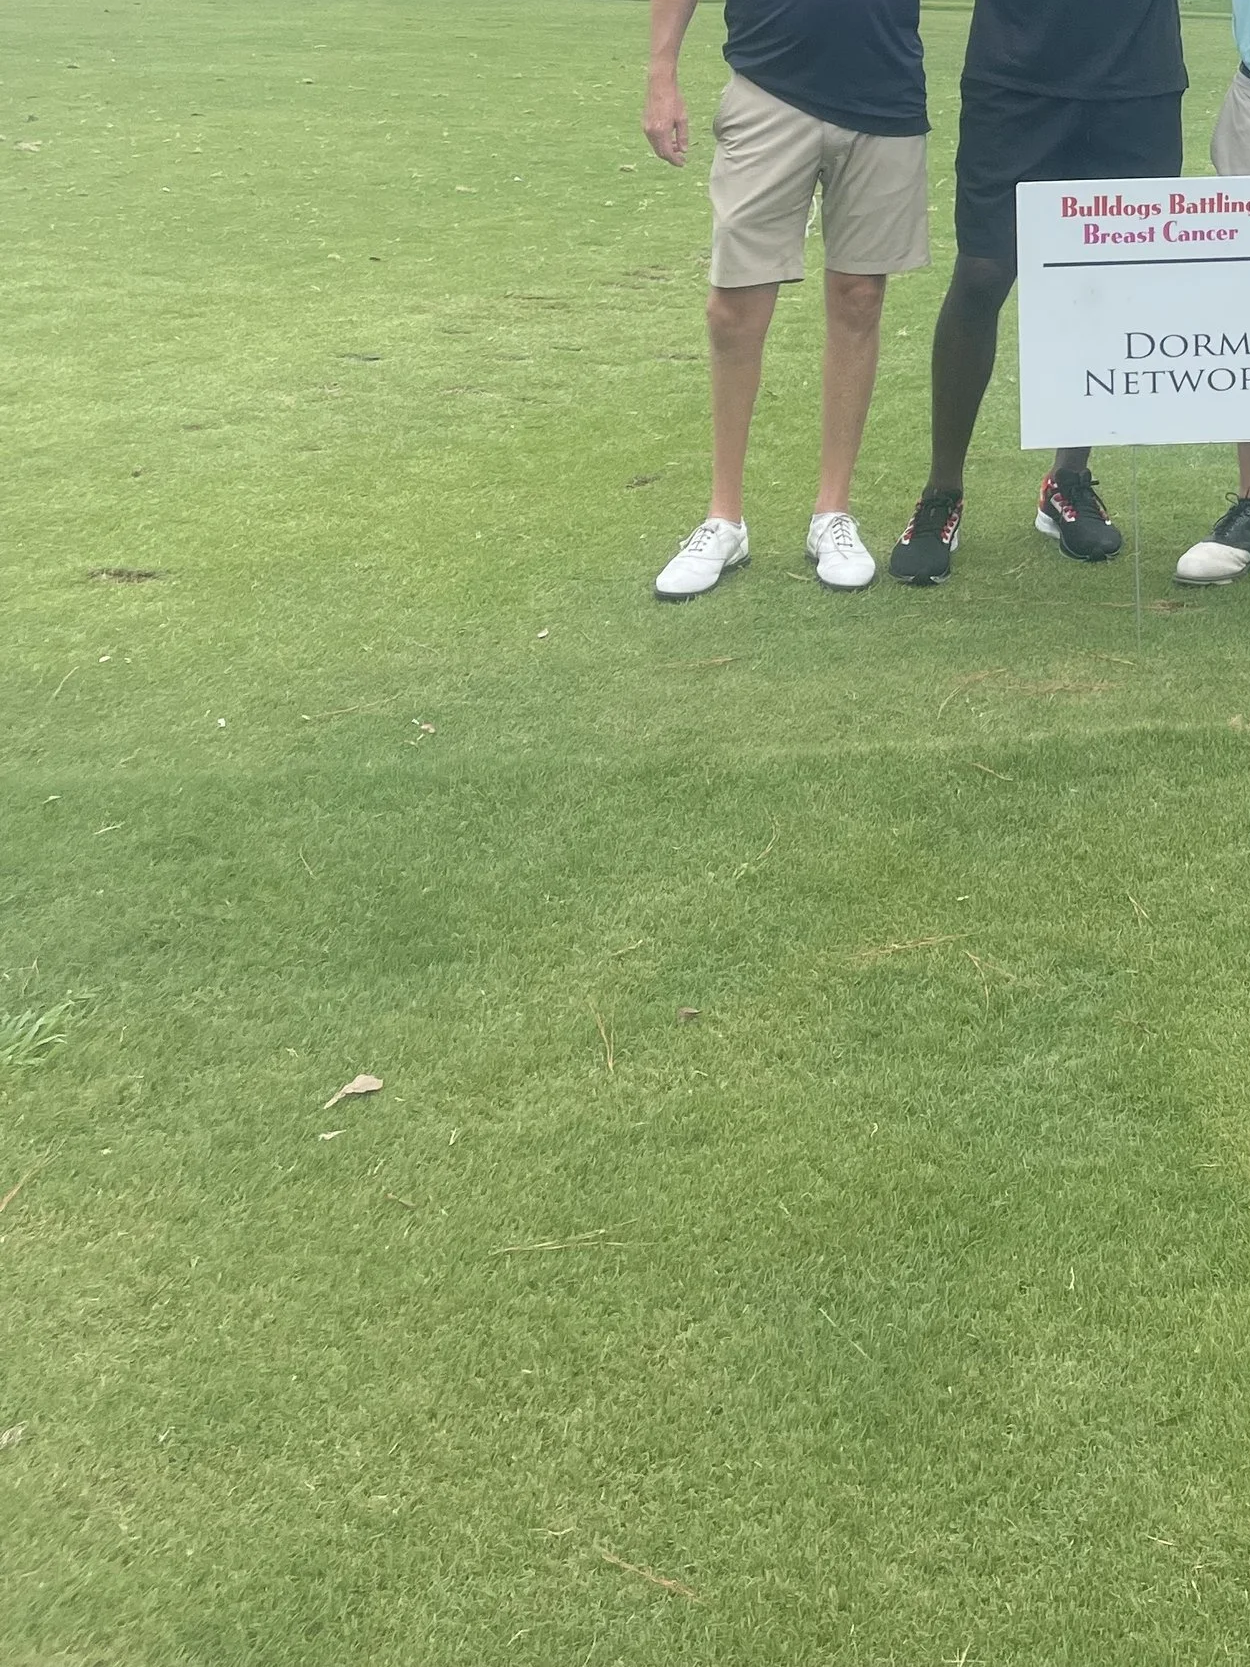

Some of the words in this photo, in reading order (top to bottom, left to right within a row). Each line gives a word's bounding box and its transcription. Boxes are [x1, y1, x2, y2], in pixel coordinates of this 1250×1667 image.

[1061, 195, 1162, 220] Bulldogs
[1083, 223, 1155, 245] Breast
[1162, 220, 1239, 243] Cancer
